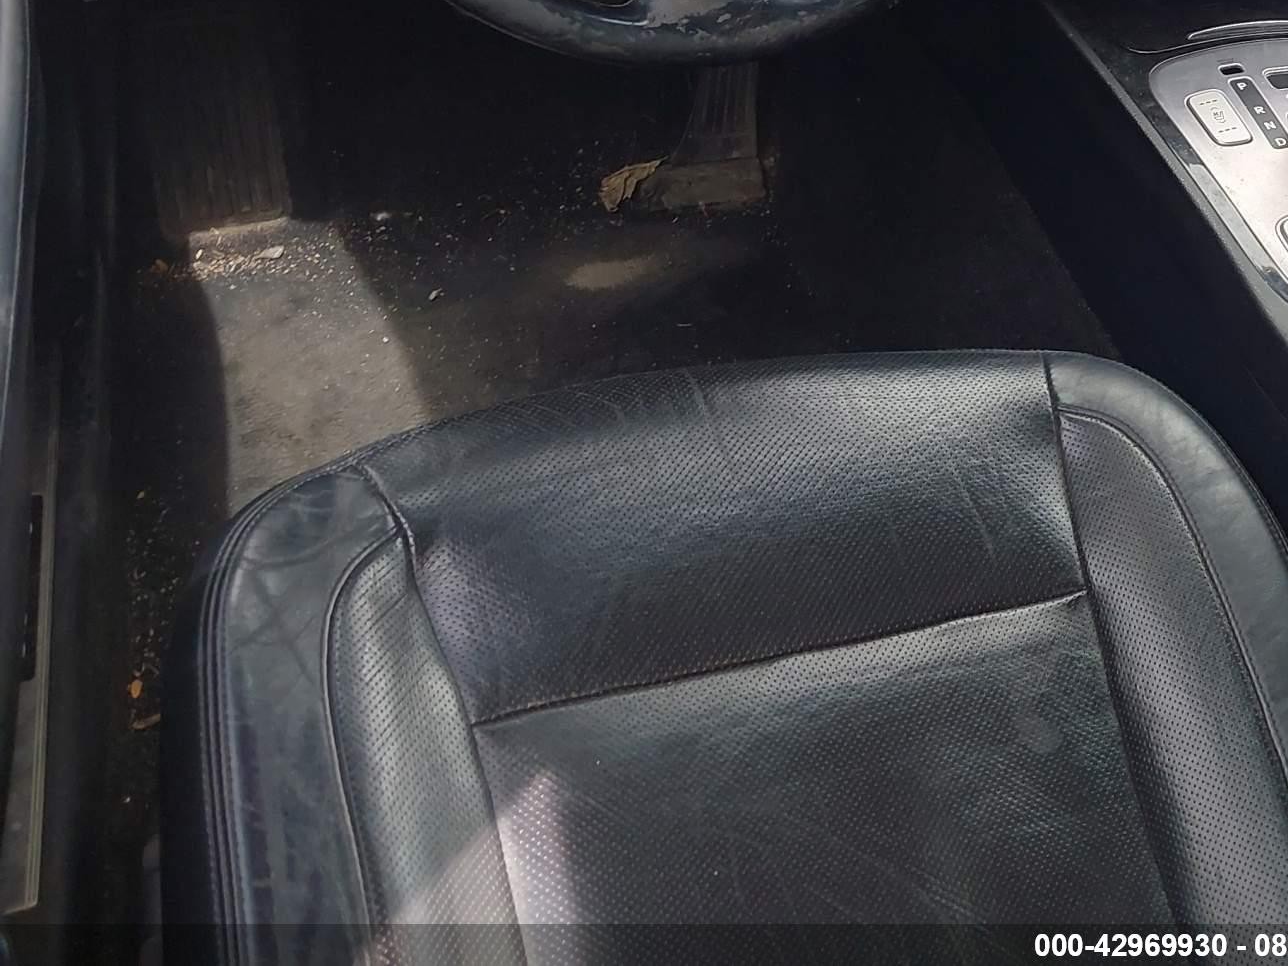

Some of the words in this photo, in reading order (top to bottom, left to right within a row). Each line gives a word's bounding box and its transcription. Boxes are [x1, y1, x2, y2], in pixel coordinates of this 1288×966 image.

[1236, 82, 1248, 90] P
[1253, 106, 1266, 115] R
[1264, 121, 1277, 130] N
[1274, 138, 1287, 147] D
